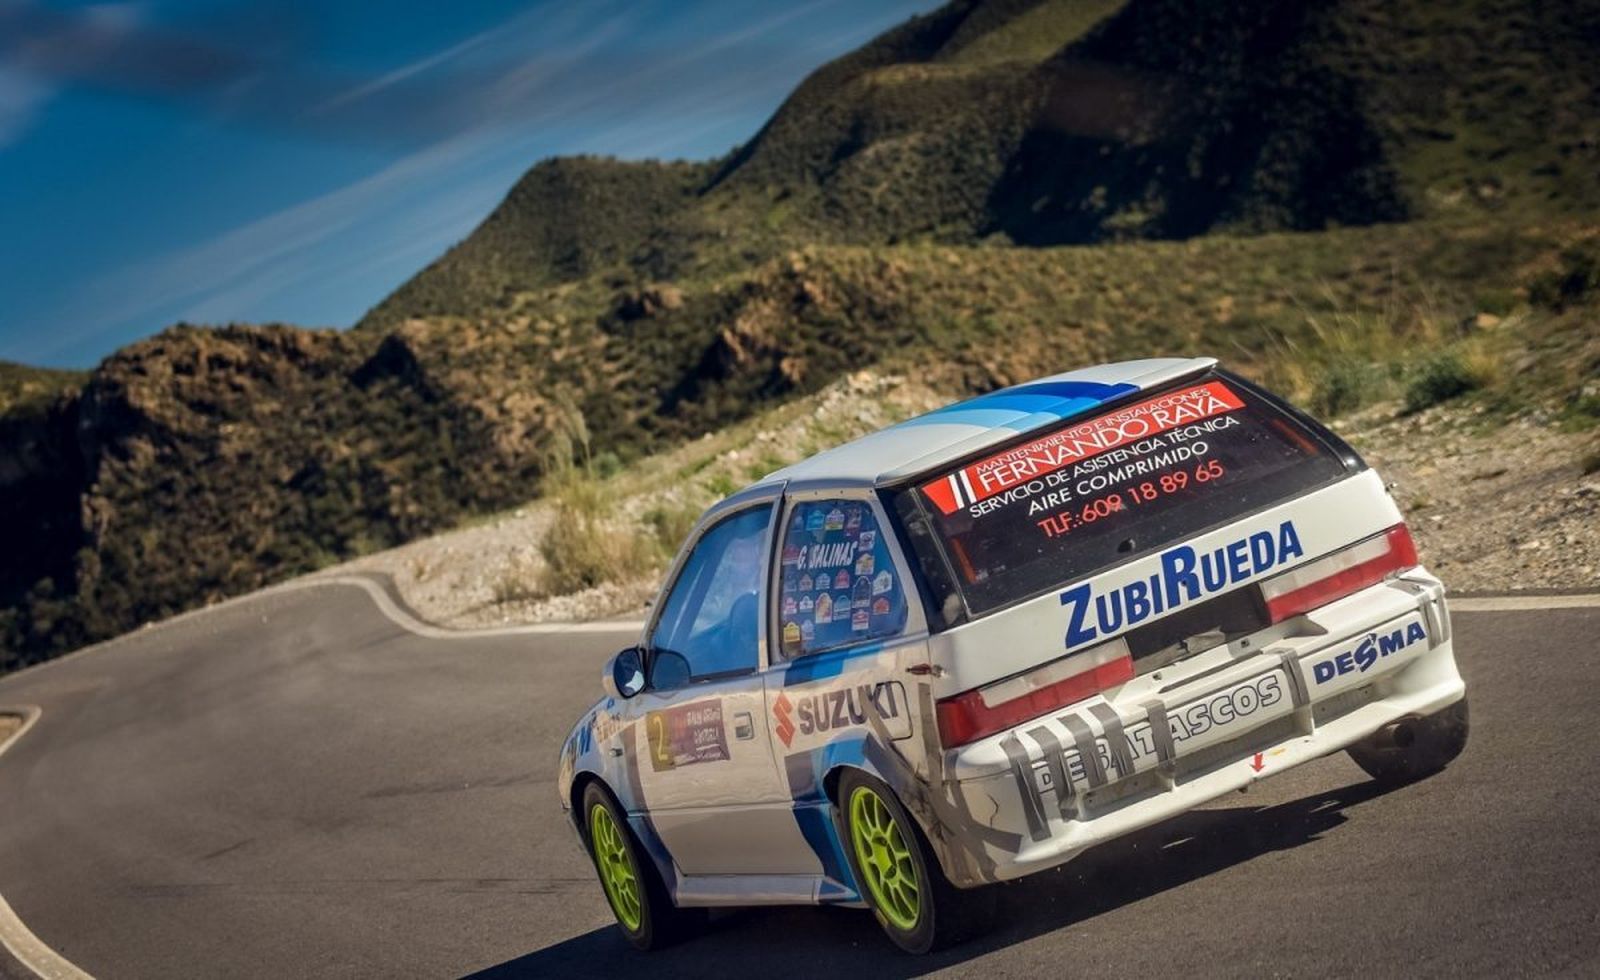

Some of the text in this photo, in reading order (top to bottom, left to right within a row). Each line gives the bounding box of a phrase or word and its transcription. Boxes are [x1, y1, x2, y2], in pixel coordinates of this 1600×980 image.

[976, 388, 1211, 475] MANTENIMIENTO E INSTALACIONES
[979, 395, 1232, 493] FERNANDO RAYA
[969, 415, 1240, 518] SERVICIO DE ASISTENCIA TÉCNICA
[1028, 441, 1209, 516] AIRE COMPRIMIDO
[1127, 482, 1158, 505] 18
[1160, 471, 1188, 493] 89
[1195, 459, 1224, 482] 65
[809, 541, 858, 568] SALINAS
[1312, 621, 1426, 685] DESMA
[653, 714, 668, 761] 2
[798, 681, 898, 735] SUZUKI
